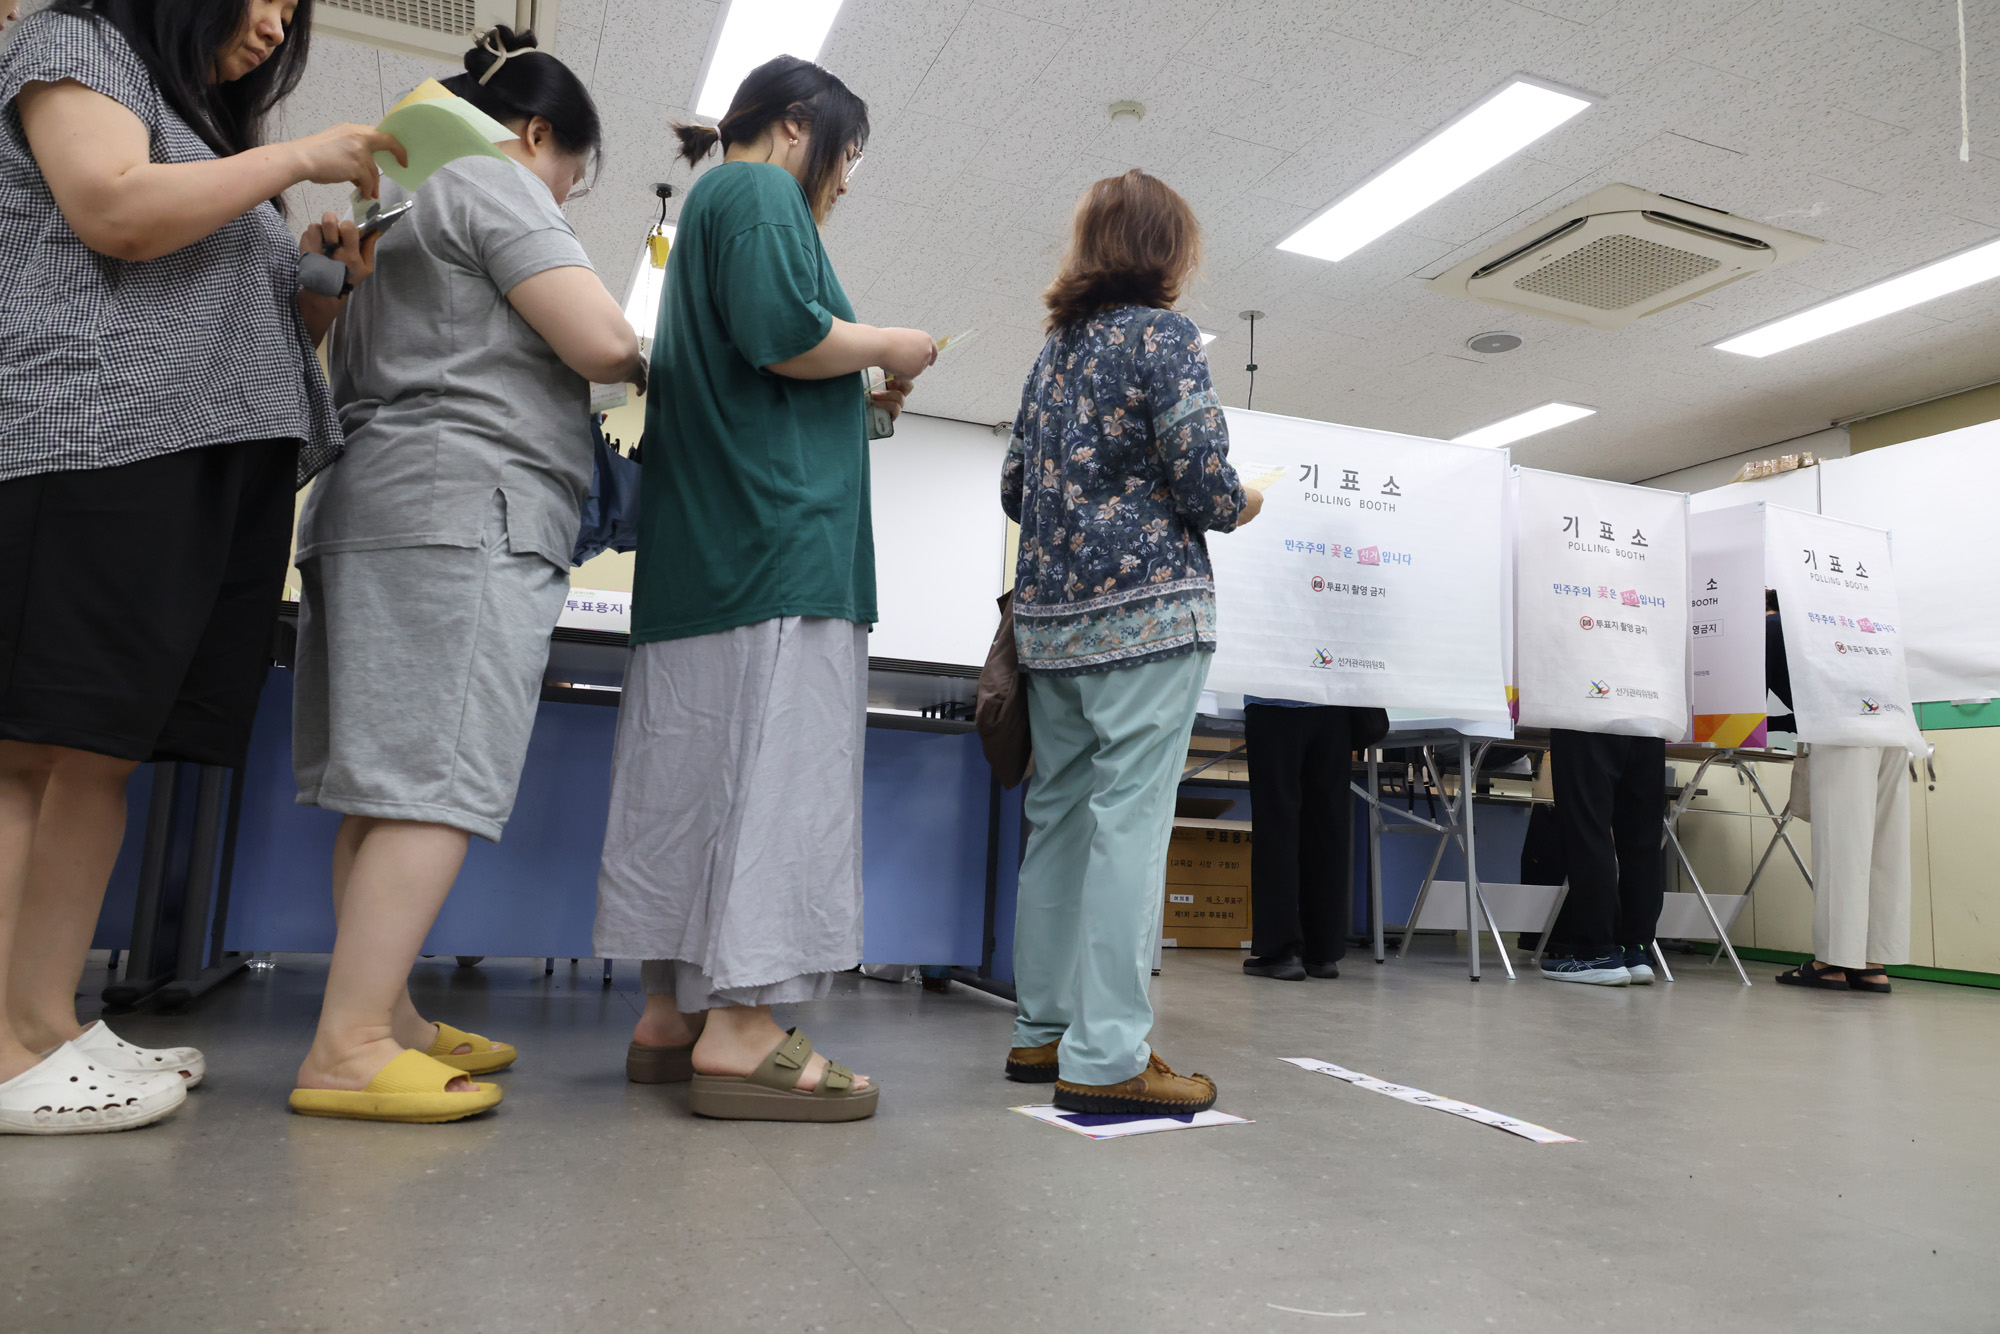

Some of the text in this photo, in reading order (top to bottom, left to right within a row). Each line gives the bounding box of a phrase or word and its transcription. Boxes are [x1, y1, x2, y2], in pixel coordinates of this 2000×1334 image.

[1304, 492, 1396, 512] POLLING BOOTH
[1285, 539, 1326, 556] 민주주의
[1331, 543, 1353, 559] 꽃은
[1568, 541, 1646, 561] POLLING BOOTH
[1327, 581, 1386, 597] 투표지 촬영 금지
[1810, 572, 1869, 591] POLLING BOOTH
[1553, 583, 1591, 598] 민주주의
[1597, 585, 1617, 600] 꽃은
[565, 600, 623, 615] 투표용지
[1692, 597, 1718, 607] BOOTH
[1808, 612, 1836, 626] 민주주의
[1596, 619, 1648, 636] 투표지 촬영 금지
[1692, 623, 1717, 635] 영금지
[1337, 657, 1386, 671] 선거관리위원회
